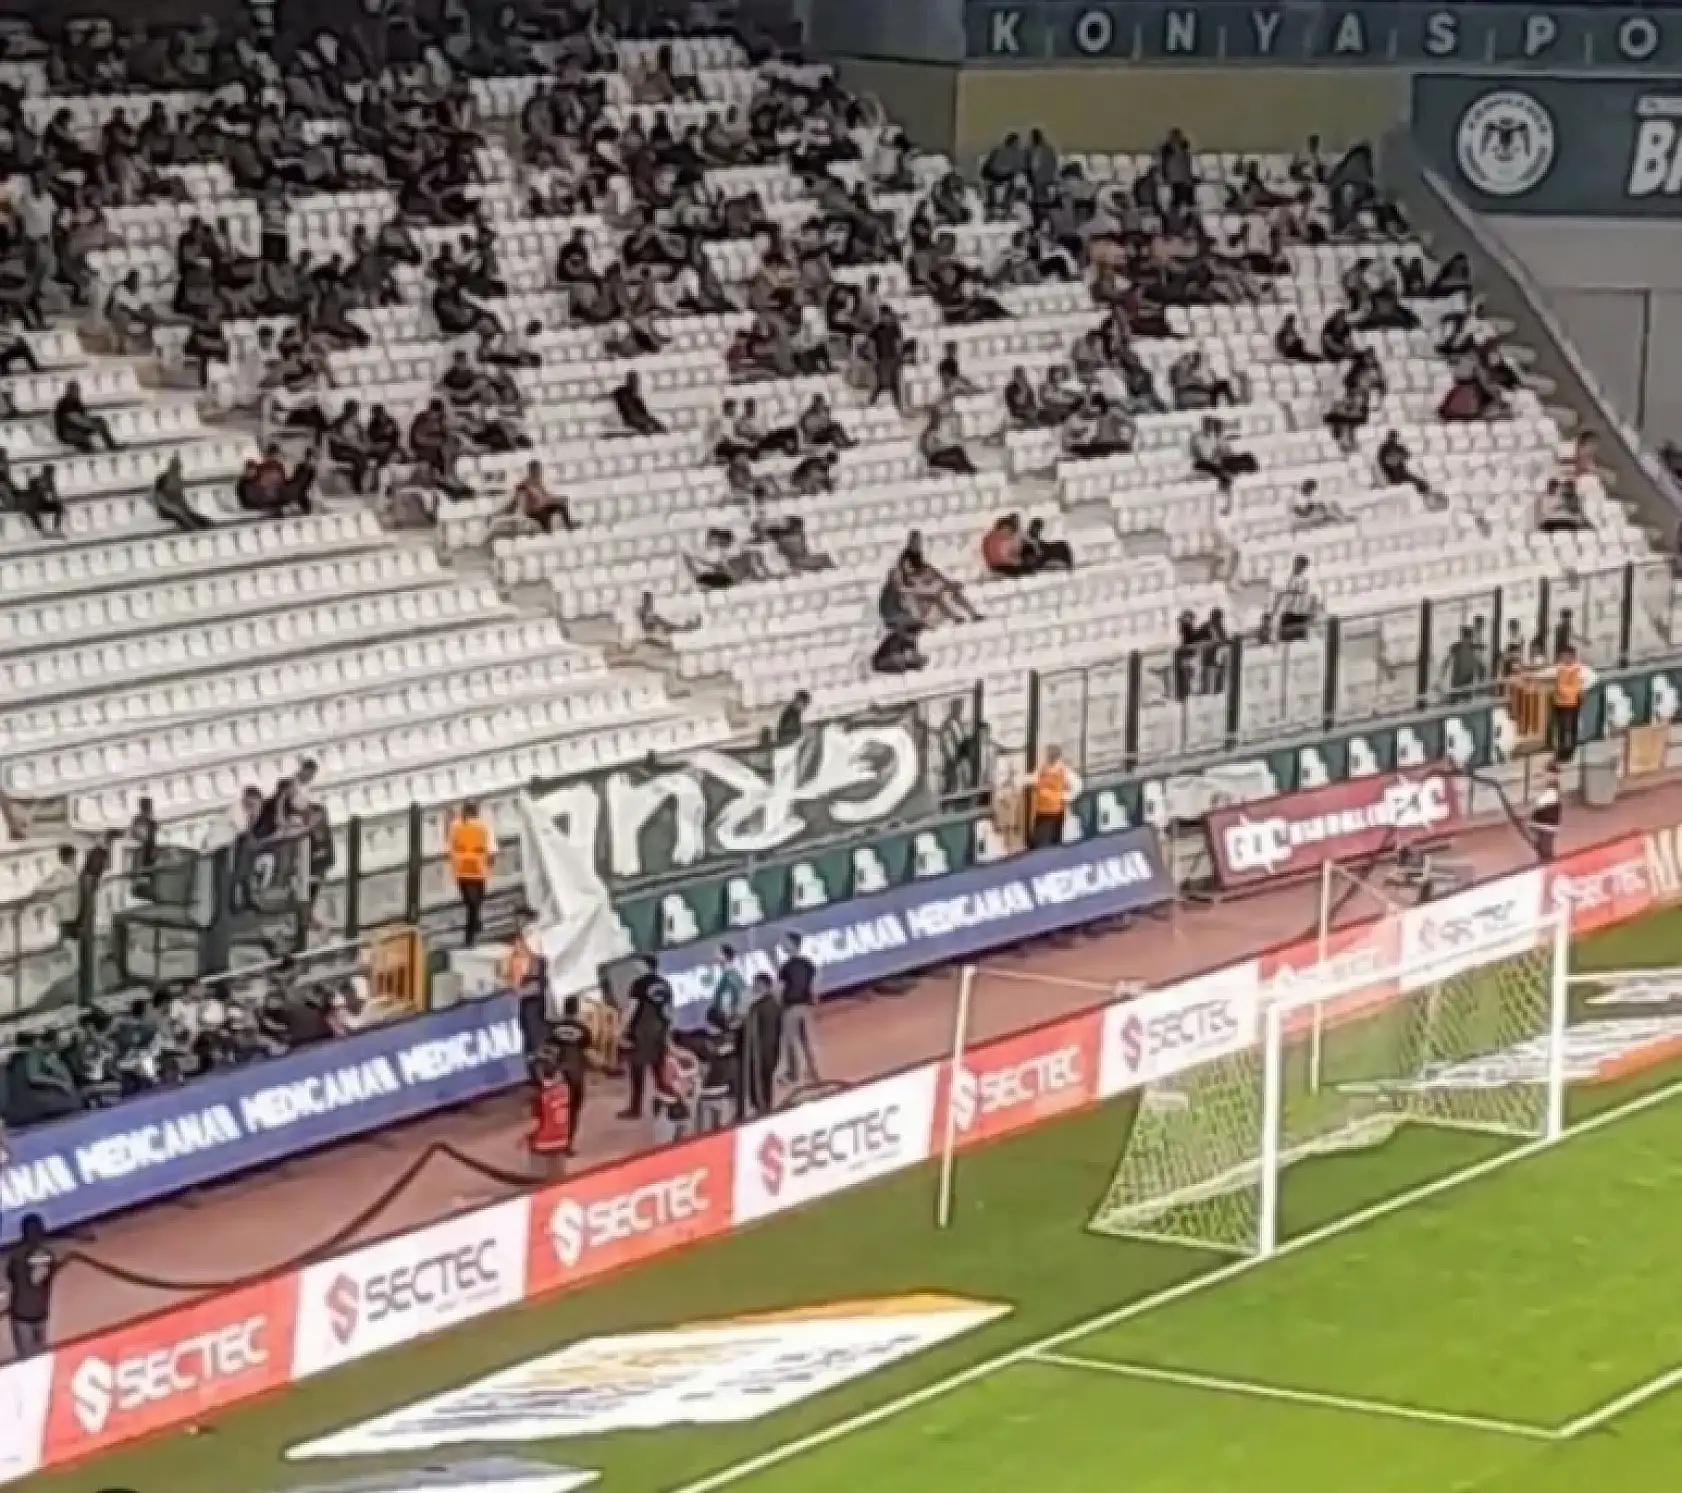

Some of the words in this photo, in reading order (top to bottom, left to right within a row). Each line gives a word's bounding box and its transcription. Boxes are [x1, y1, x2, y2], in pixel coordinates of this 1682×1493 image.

[992, 11, 1659, 58] KONYASPO
[396, 1018, 524, 1086] MEDICAN
[115, 1316, 268, 1410] SECTEC
[364, 1238, 499, 1322] SECTEC
[586, 1168, 709, 1247] SECTEC
[788, 1104, 901, 1176] SECTEC
[980, 1044, 1083, 1114] SECTEC
[1148, 999, 1239, 1056] SECTEC
